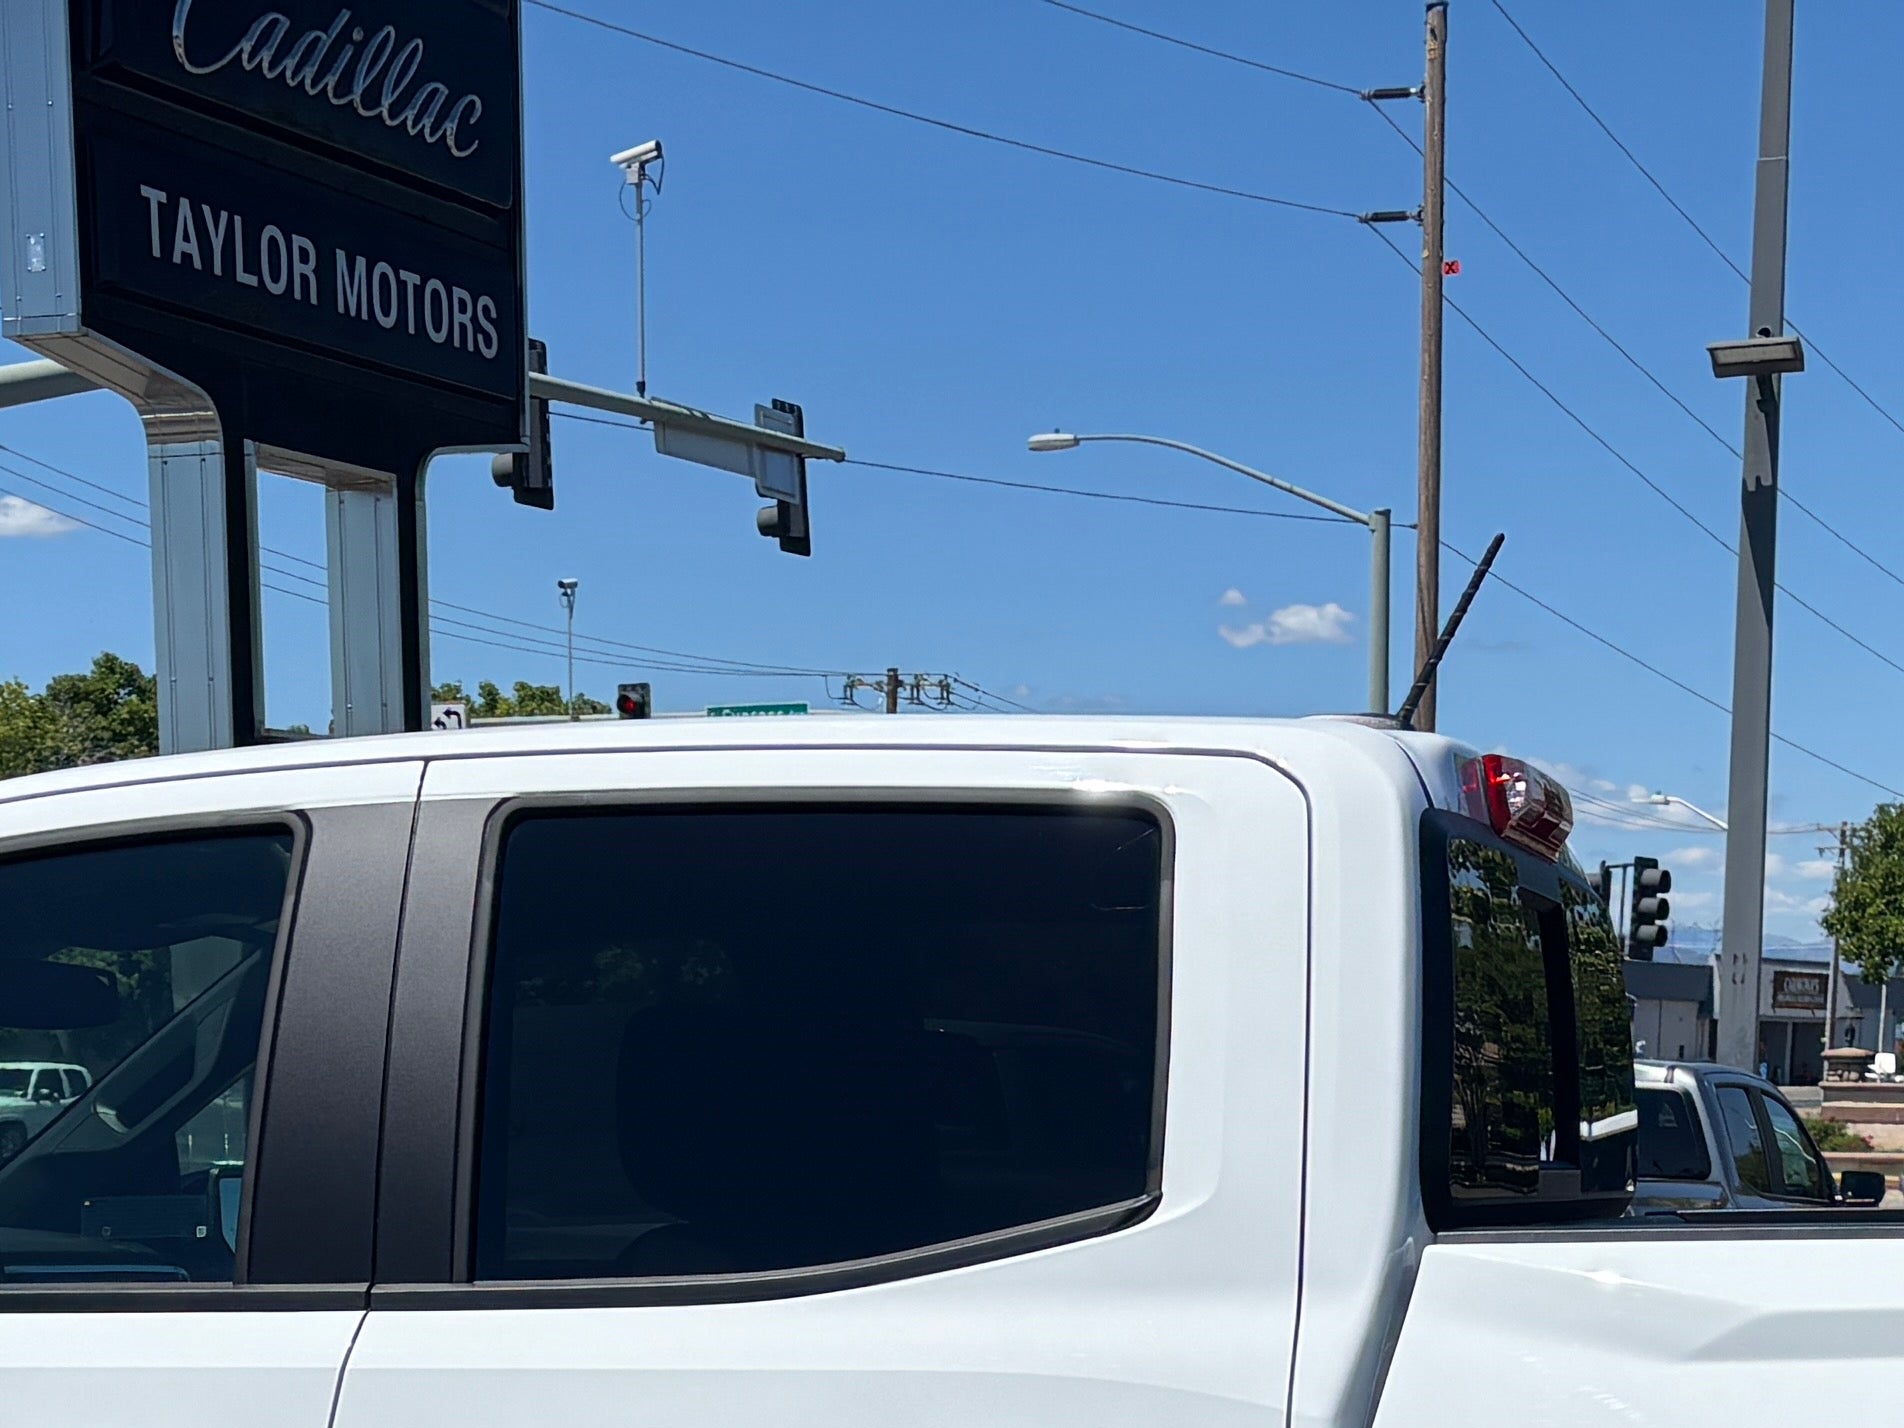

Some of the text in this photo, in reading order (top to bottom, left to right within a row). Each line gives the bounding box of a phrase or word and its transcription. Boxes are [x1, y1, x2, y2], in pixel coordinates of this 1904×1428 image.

[172, 0, 482, 158] Cadillac
[140, 184, 499, 359] TAYLOR MOTORS
